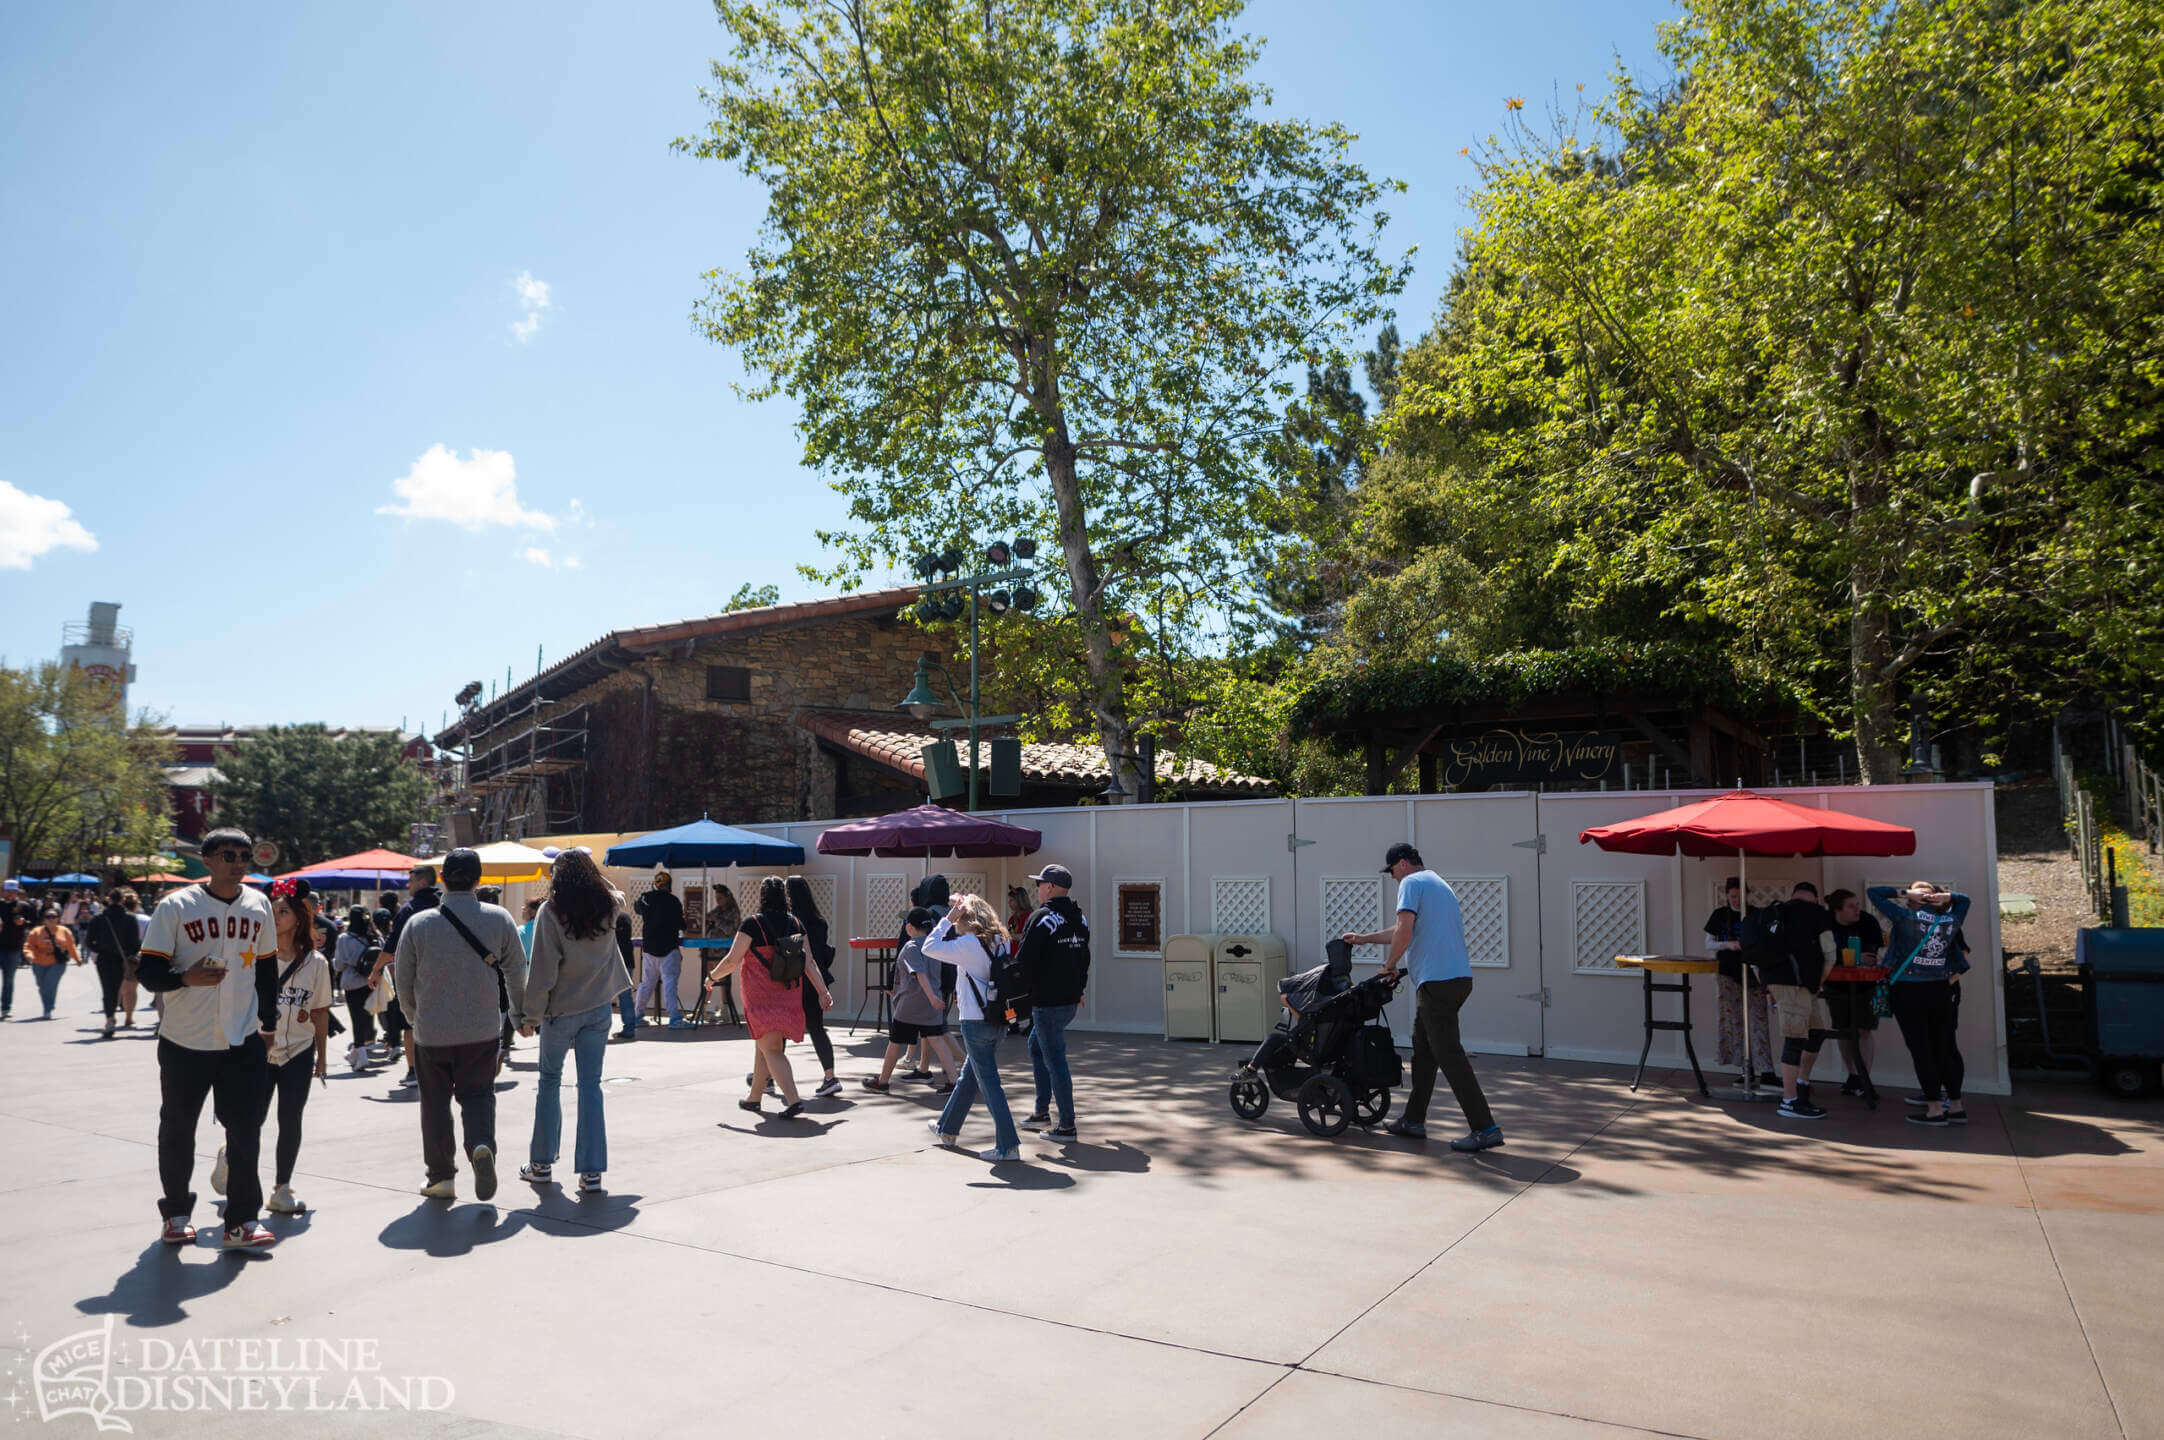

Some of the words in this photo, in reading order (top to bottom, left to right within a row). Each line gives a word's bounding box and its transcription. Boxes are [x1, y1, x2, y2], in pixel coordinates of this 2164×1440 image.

[1445, 740, 1513, 785] Golden
[1480, 728, 1558, 771] Vine
[1551, 730, 1616, 779] Winery
[183, 915, 261, 945] WOODY
